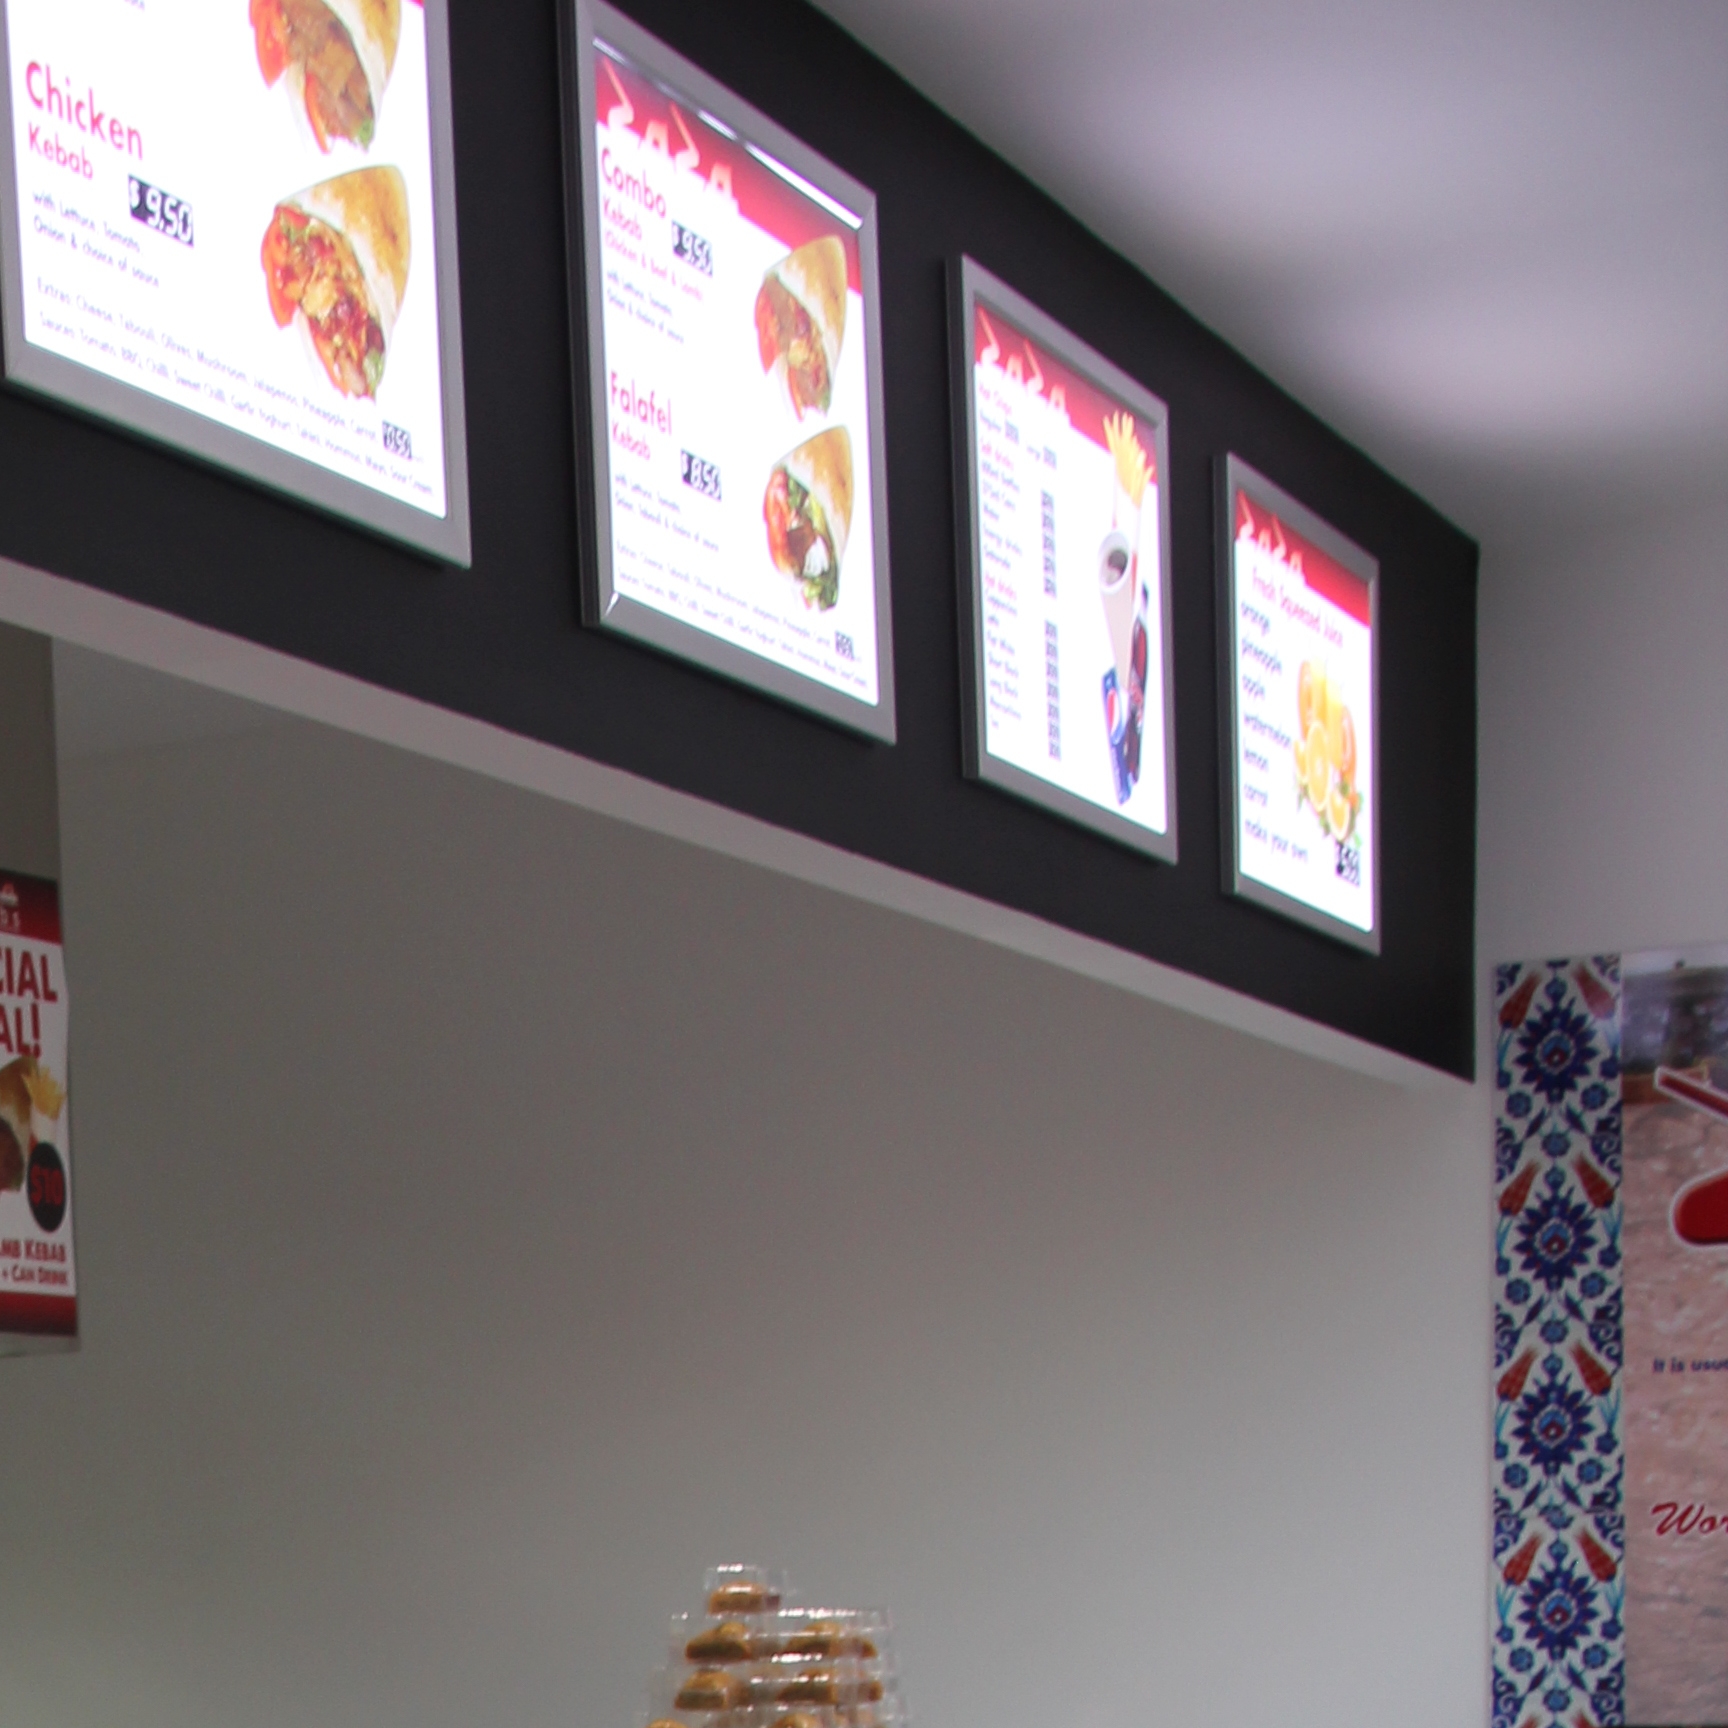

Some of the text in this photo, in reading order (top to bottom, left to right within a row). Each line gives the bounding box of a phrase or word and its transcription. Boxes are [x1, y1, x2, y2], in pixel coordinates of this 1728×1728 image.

[25, 59, 143, 161] Chicken
[28, 120, 94, 181] Kebab
[601, 146, 666, 219] Combo
[603, 194, 643, 241] Kebab
[611, 369, 672, 436] Falafel
[30, 1163, 64, 1207] $10
[25, 1239, 66, 1263] KEBAB
